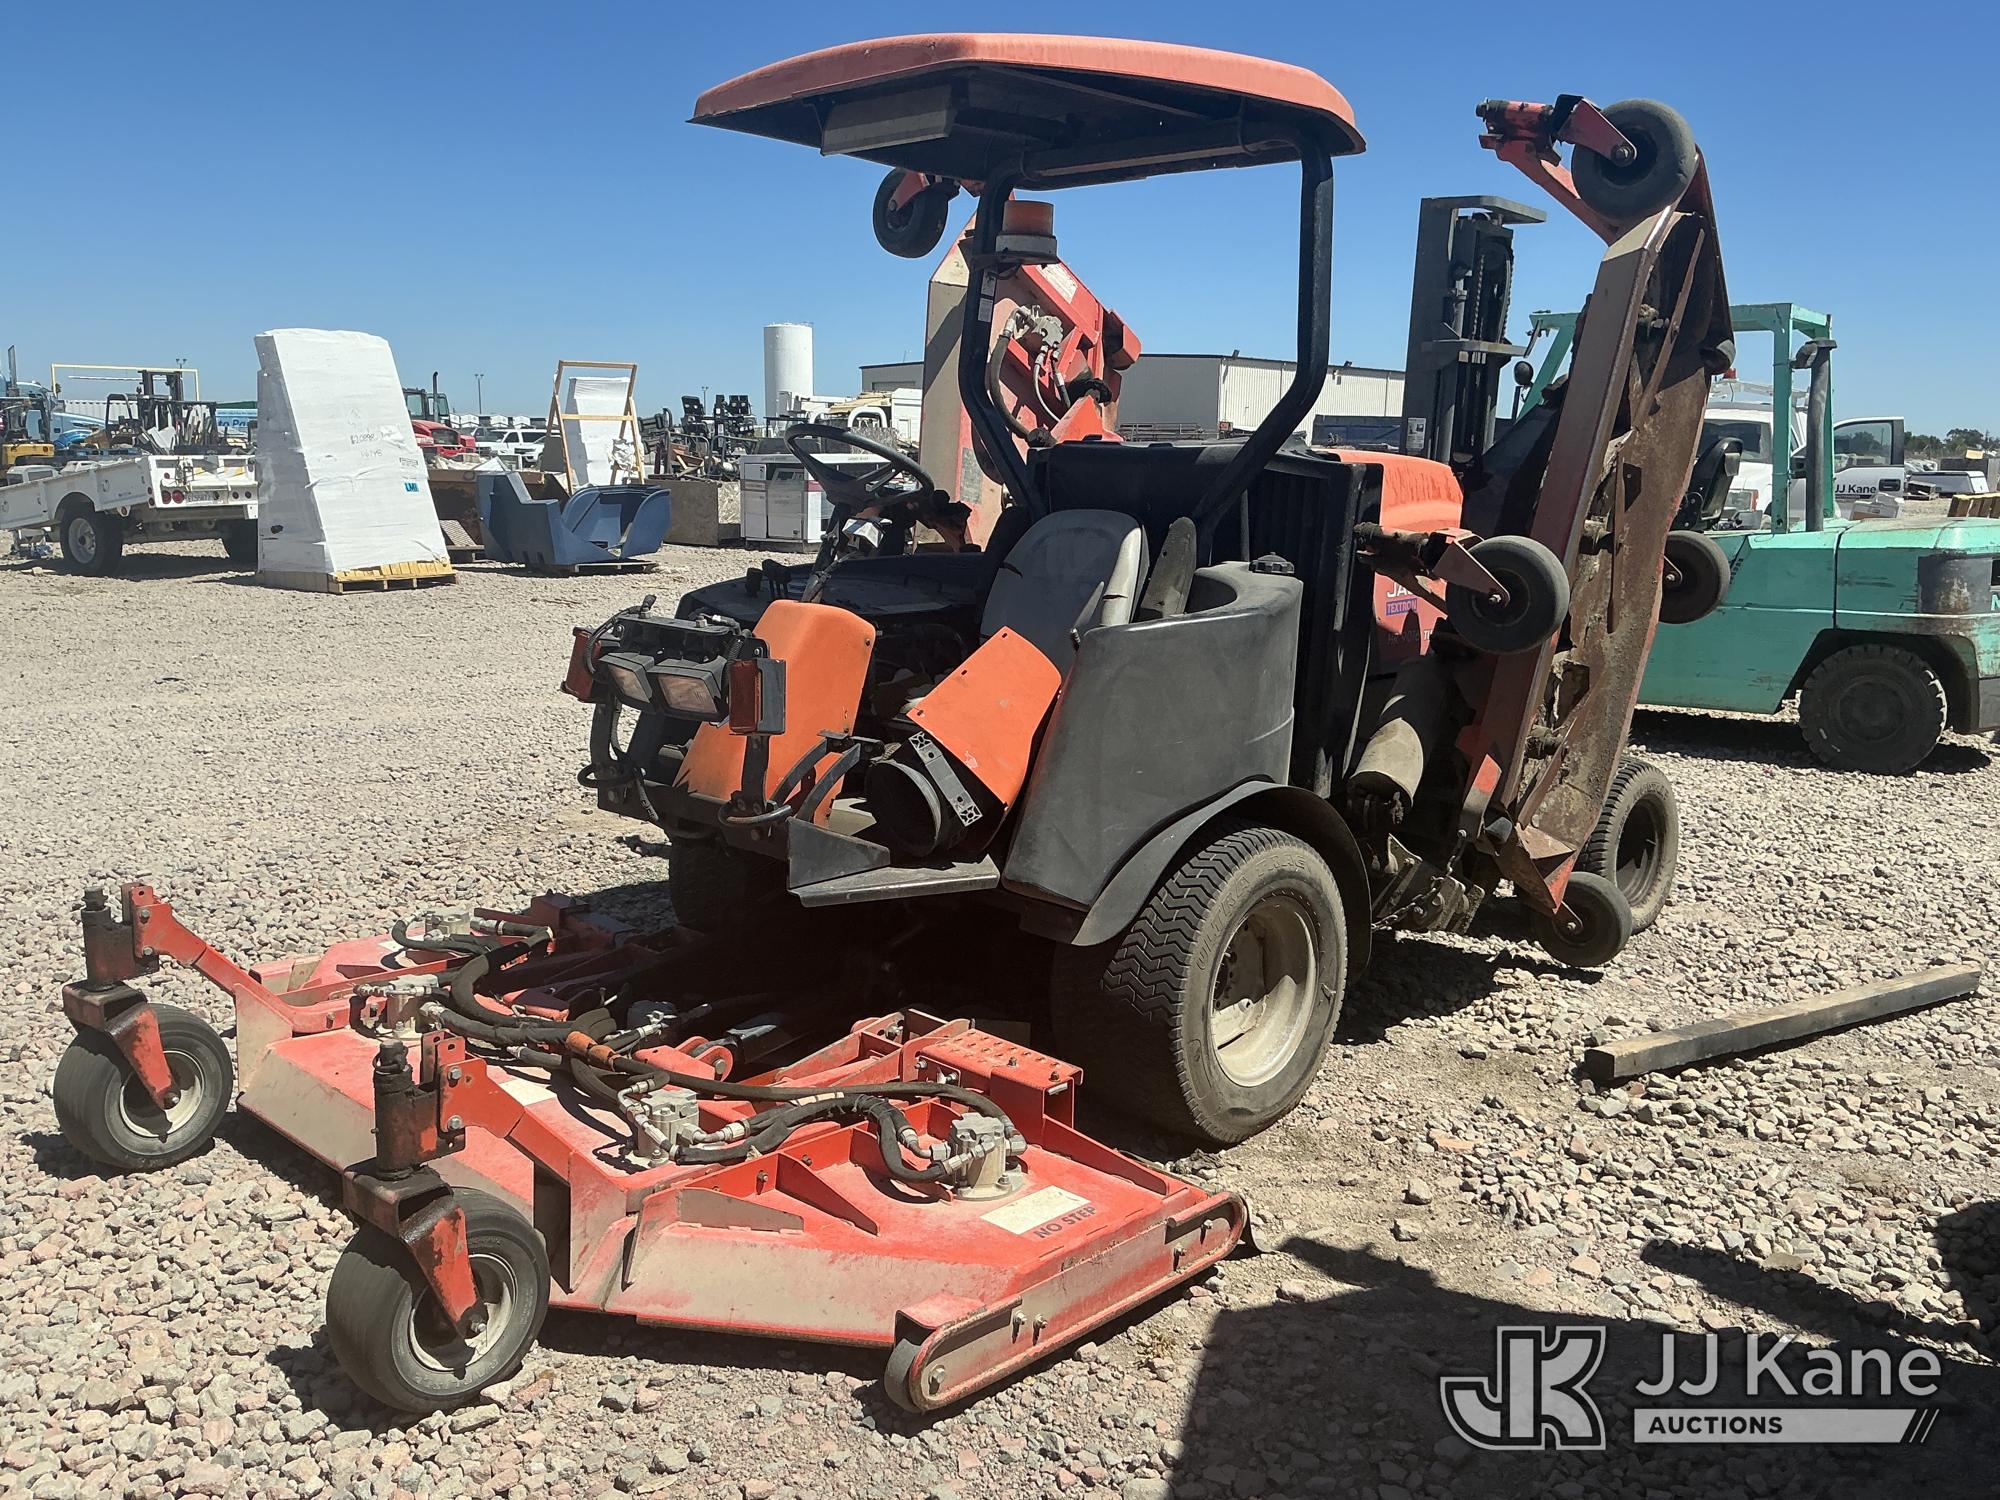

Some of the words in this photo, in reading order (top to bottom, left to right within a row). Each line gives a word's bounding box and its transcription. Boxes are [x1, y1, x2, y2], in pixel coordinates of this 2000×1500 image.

[1848, 484, 1877, 493] Kane
[1388, 600, 1417, 613] TEXTRON
[1033, 1223, 1062, 1238] NO
[1061, 1206, 1096, 1225] STEP
